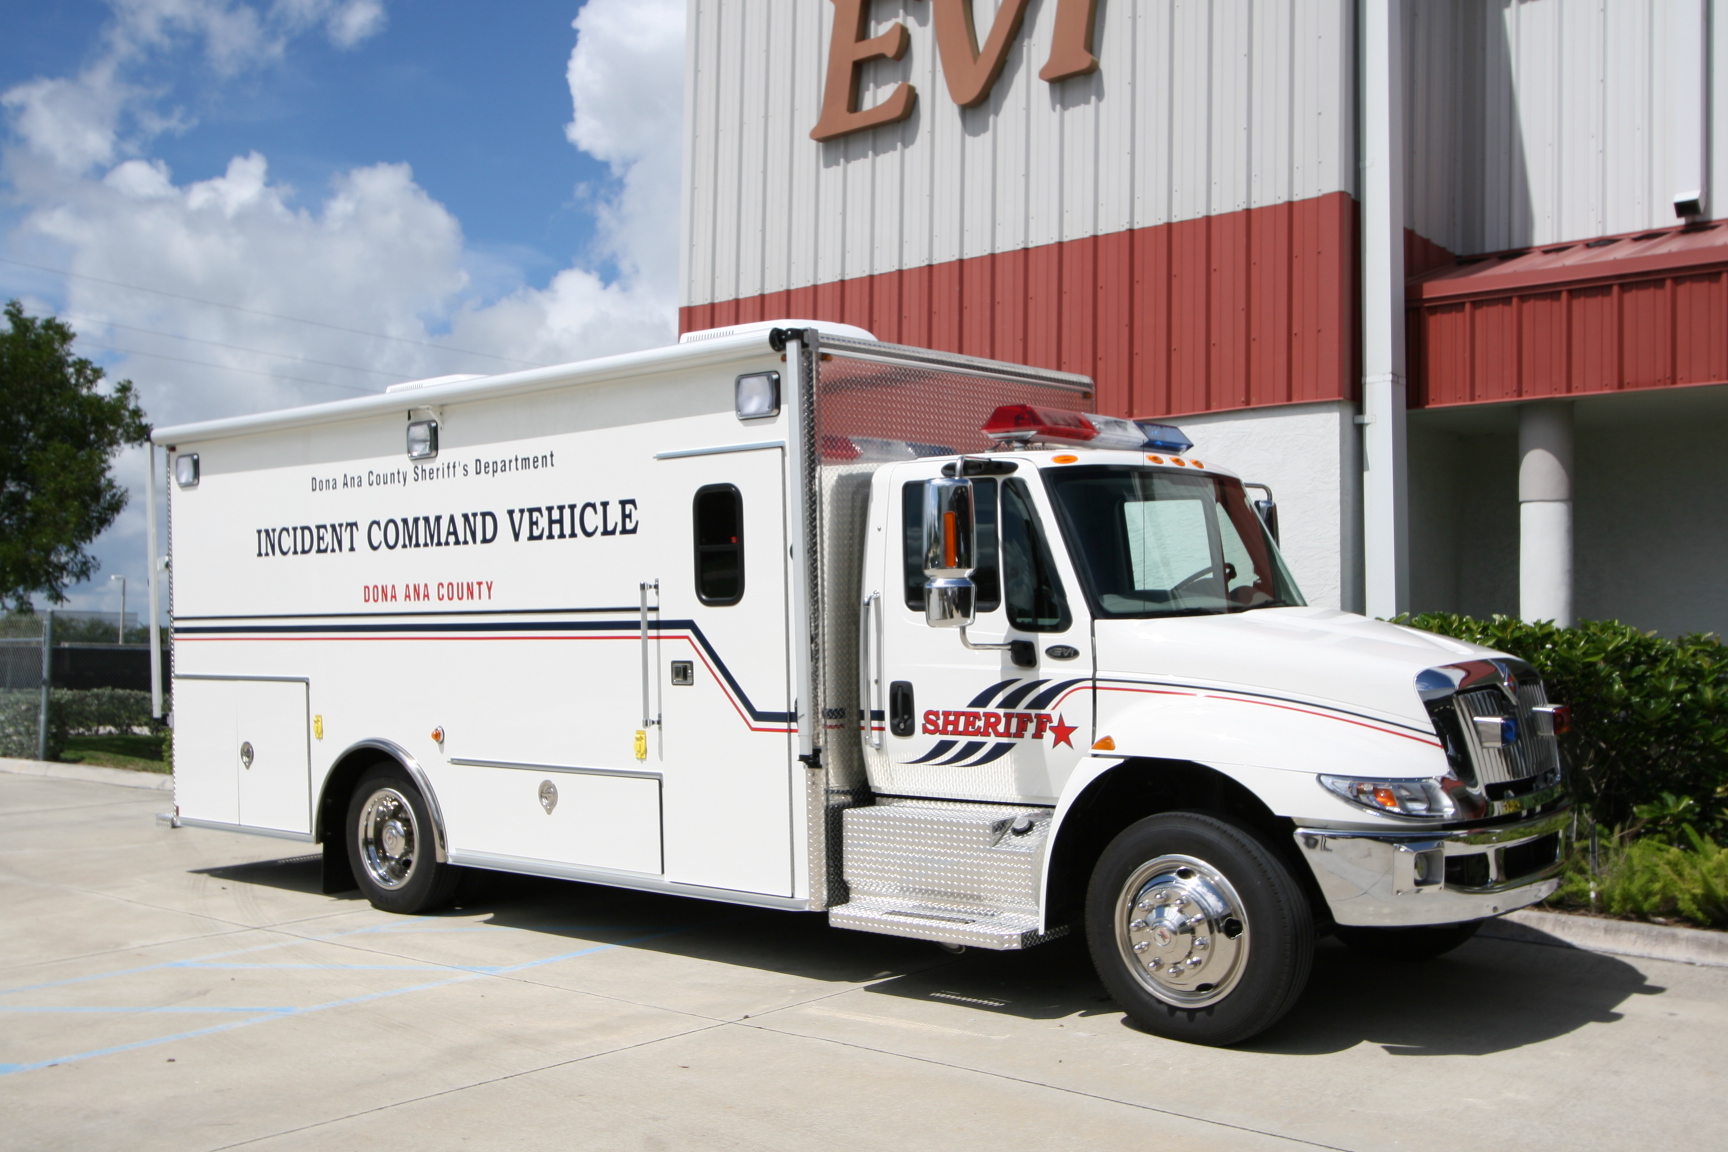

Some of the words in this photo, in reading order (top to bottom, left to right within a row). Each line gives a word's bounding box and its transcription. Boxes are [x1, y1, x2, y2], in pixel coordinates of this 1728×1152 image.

[311, 476, 337, 492] Dona
[342, 473, 363, 488] Ana
[367, 469, 407, 486] County
[413, 461, 469, 482] Sheriff's
[474, 451, 555, 478] Department
[256, 521, 359, 557] INCIDENT
[366, 511, 499, 551] COMMAND
[506, 498, 639, 542] VEHICLE
[363, 584, 398, 603] DONA
[404, 583, 430, 601] ANA
[437, 581, 494, 602] COUNTY
[922, 709, 1053, 739] SHERIFF
